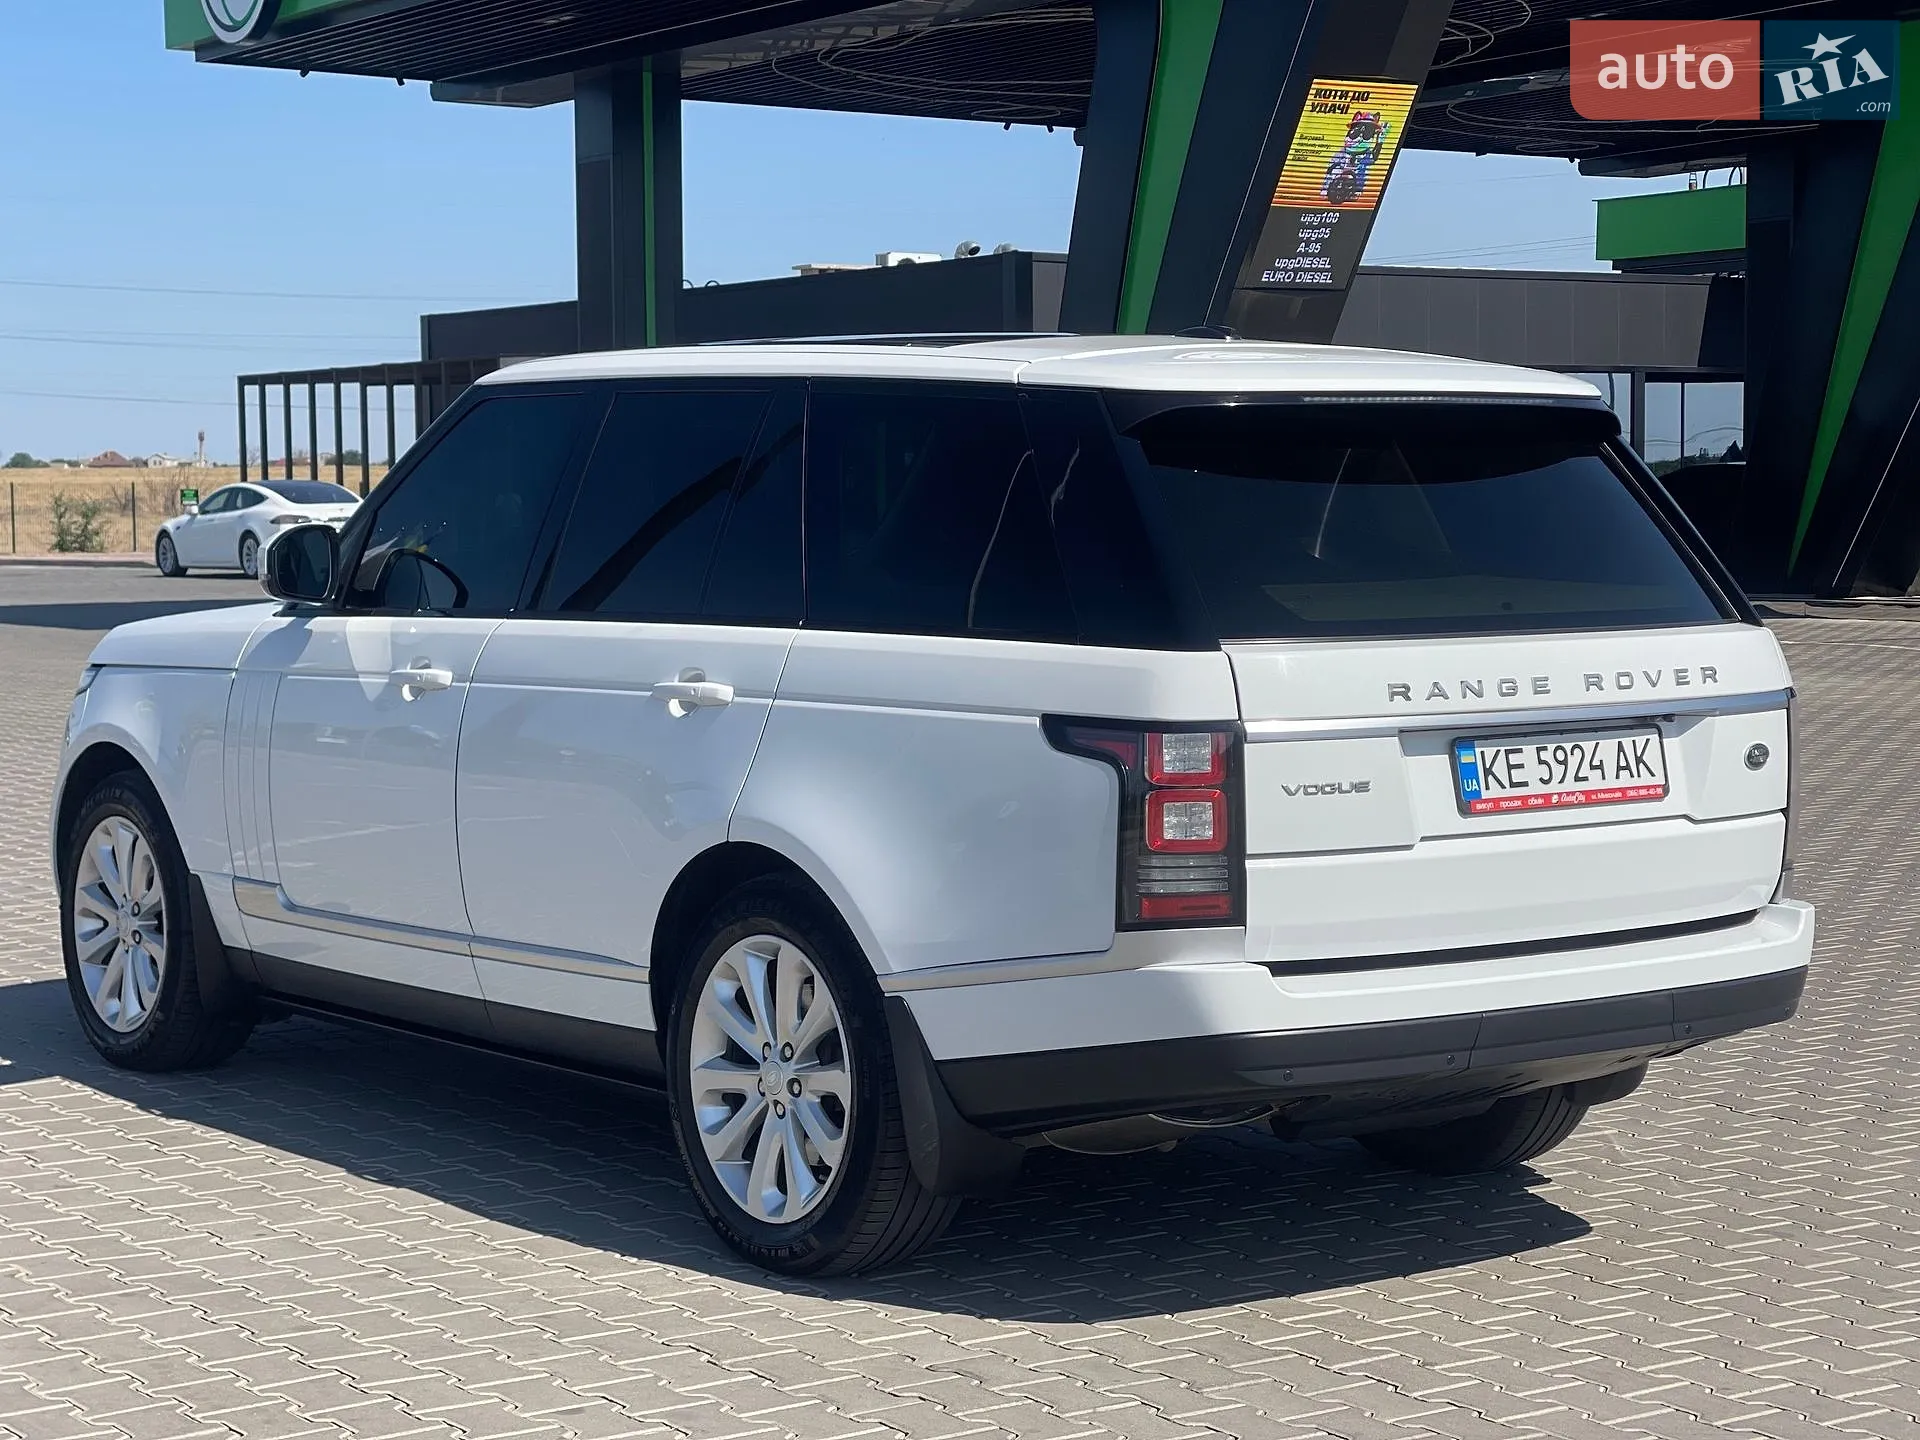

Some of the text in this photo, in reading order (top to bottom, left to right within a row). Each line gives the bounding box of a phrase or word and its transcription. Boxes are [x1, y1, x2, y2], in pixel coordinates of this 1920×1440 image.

[1300, 212, 1340, 225] upg100
[1298, 228, 1331, 240] upg95
[1274, 257, 1332, 269] upgDIESEL
[1261, 271, 1333, 283] EURO DIESEL
[1387, 666, 1719, 703] RANGE ROVER
[1480, 738, 1657, 791] KE 5924 AK
[1281, 781, 1371, 797] VOGUE
[1463, 778, 1480, 792] UA
